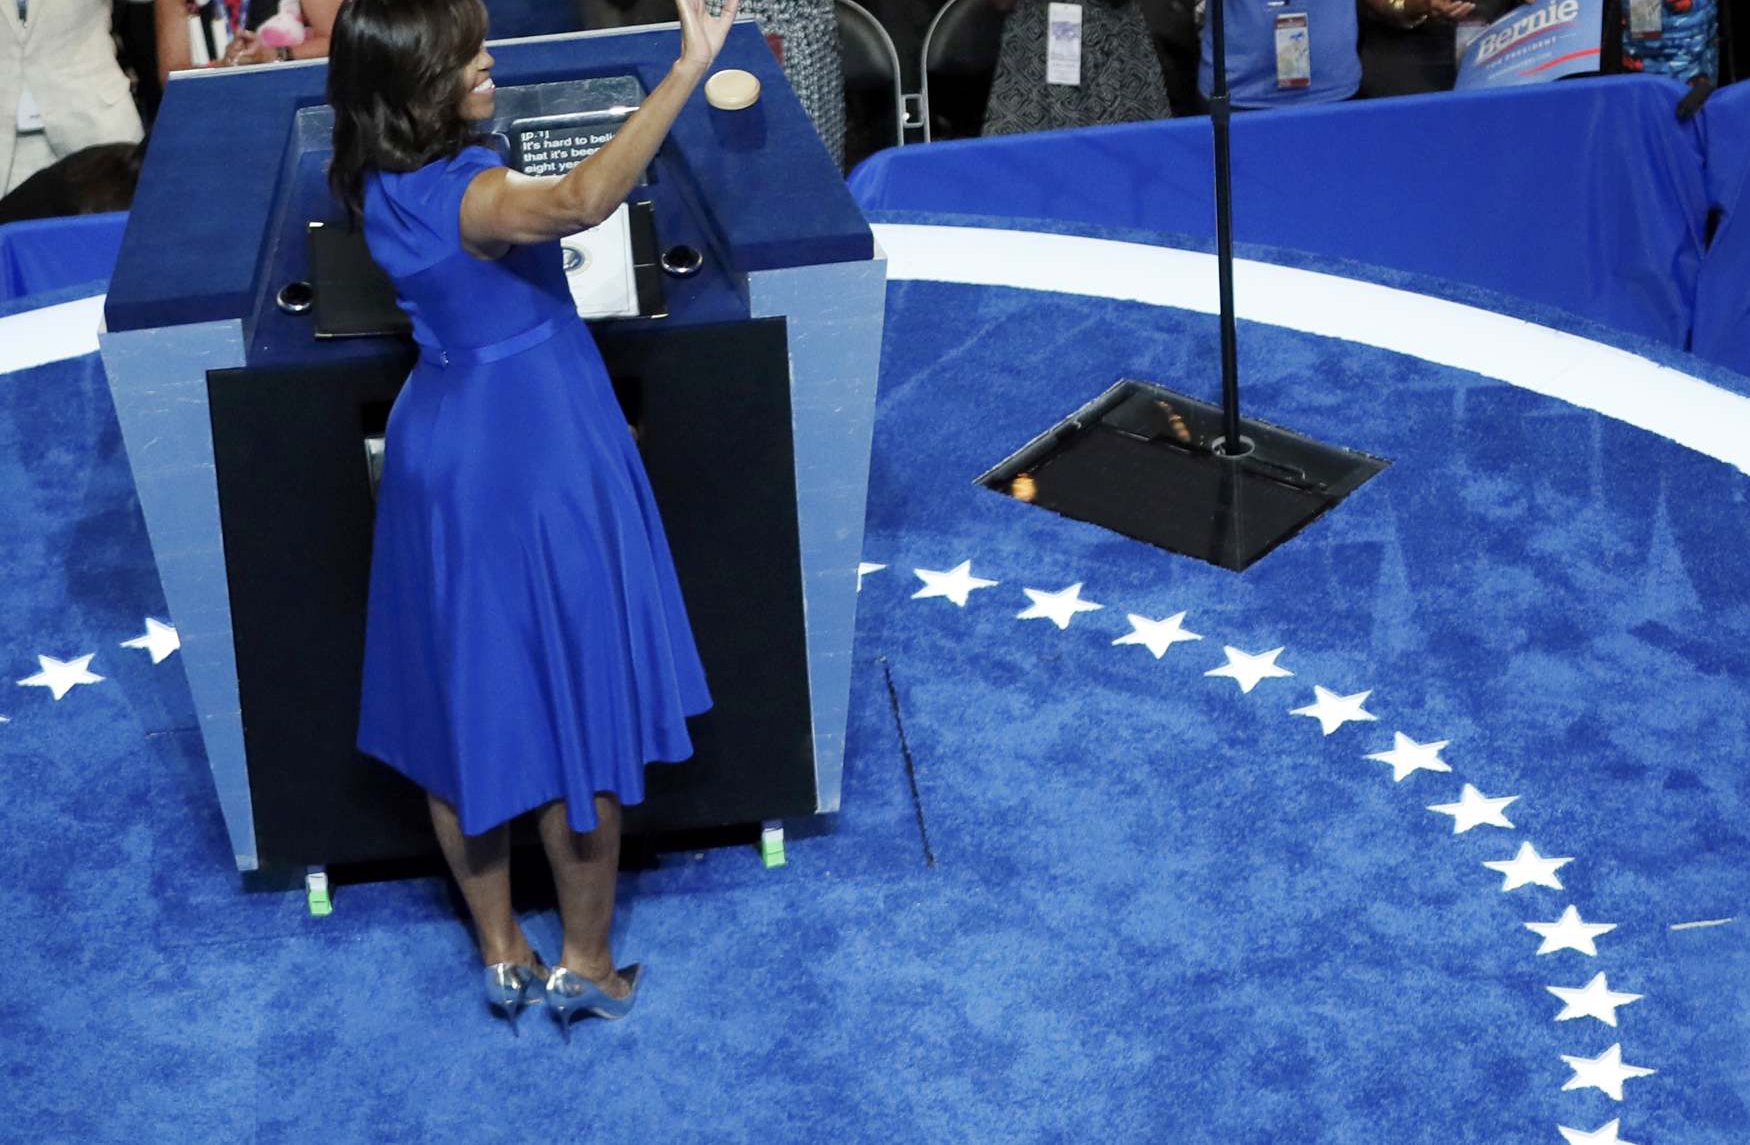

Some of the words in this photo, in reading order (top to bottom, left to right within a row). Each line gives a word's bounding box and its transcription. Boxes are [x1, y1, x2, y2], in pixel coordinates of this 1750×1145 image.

[522, 141, 541, 151] It's
[544, 137, 572, 148] hard
[575, 136, 588, 145] to
[590, 132, 615, 144] beli
[523, 152, 548, 162] that
[551, 150, 568, 159] it's
[524, 162, 556, 174] eight
